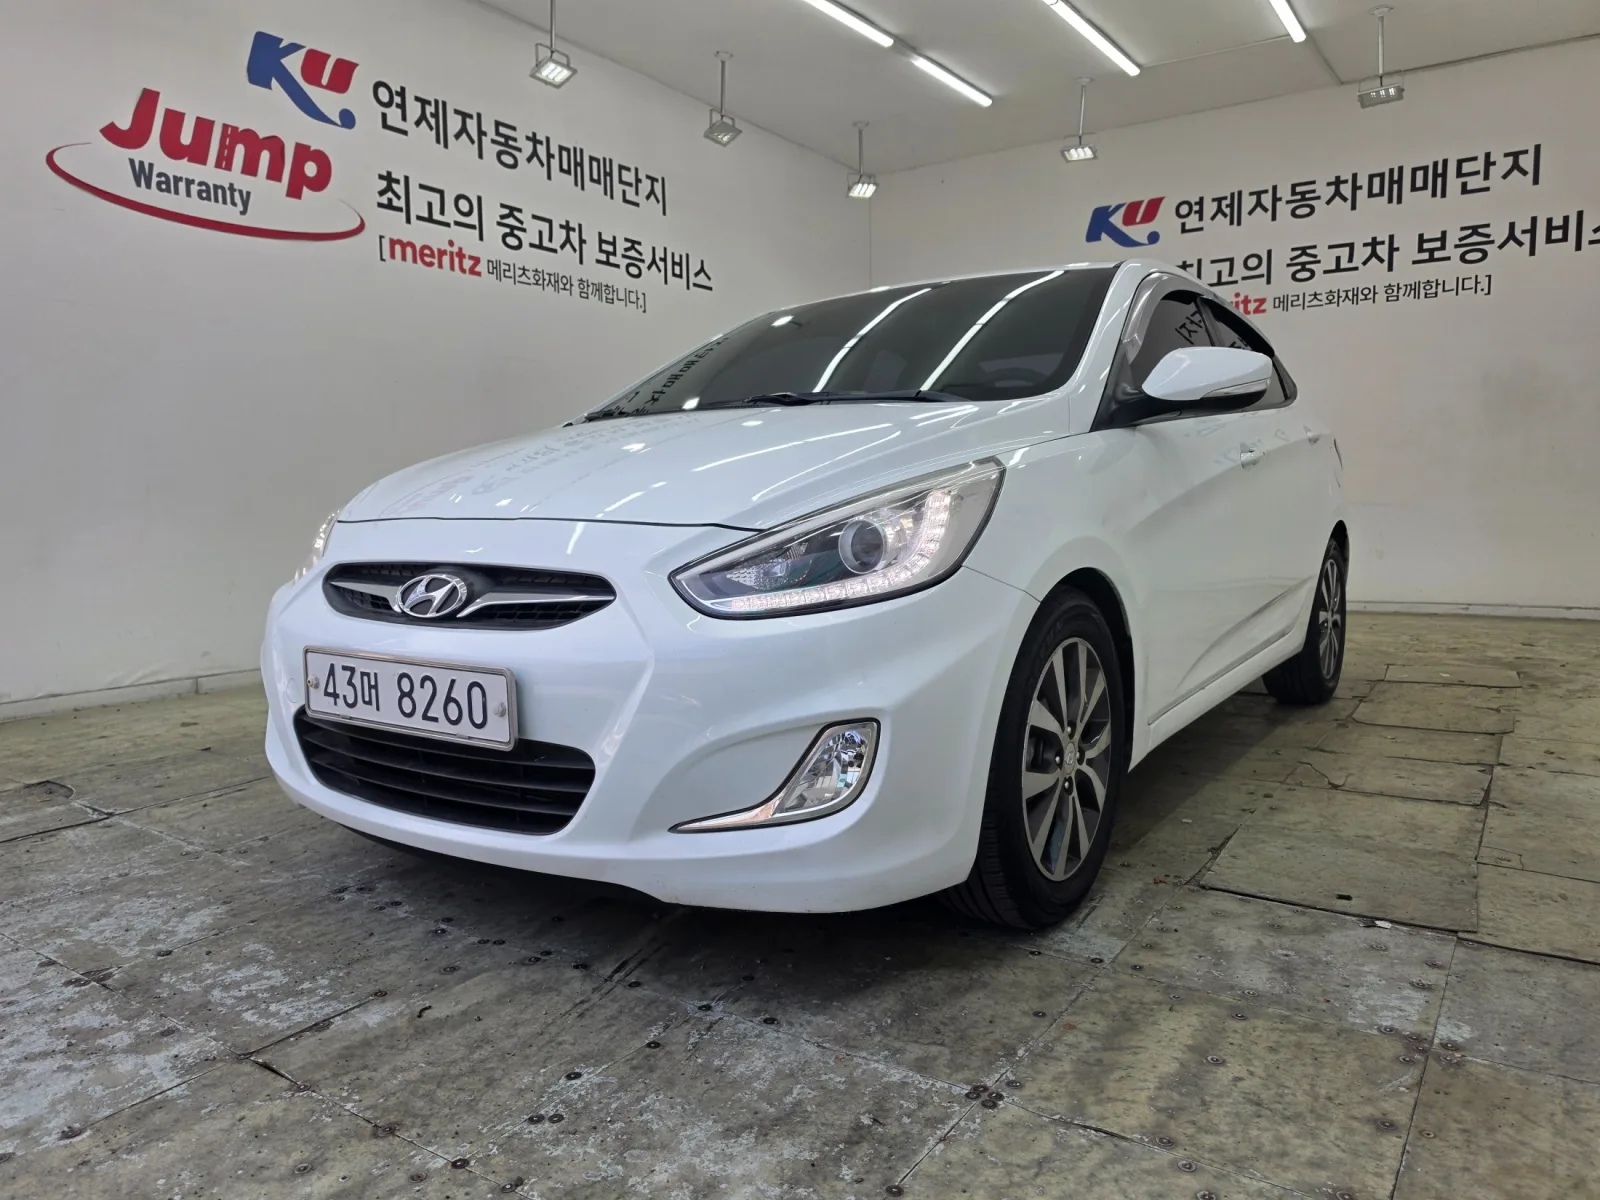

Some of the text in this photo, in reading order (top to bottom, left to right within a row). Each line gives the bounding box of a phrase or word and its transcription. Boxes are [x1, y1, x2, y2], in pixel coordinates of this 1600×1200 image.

[99, 87, 333, 200] Jump
[372, 80, 667, 216] 연제자동차매매단지
[128, 157, 251, 216] Warranty
[1175, 143, 1542, 234] 연제자동차매매단지
[377, 170, 713, 291] 최고의 중고차 보증서비스
[1286, 234, 1400, 282] 중고차
[487, 259, 573, 297] 메리츠화재와
[1272, 285, 1378, 312] 메리츠화재와
[323, 662, 488, 729] 43머 8260
